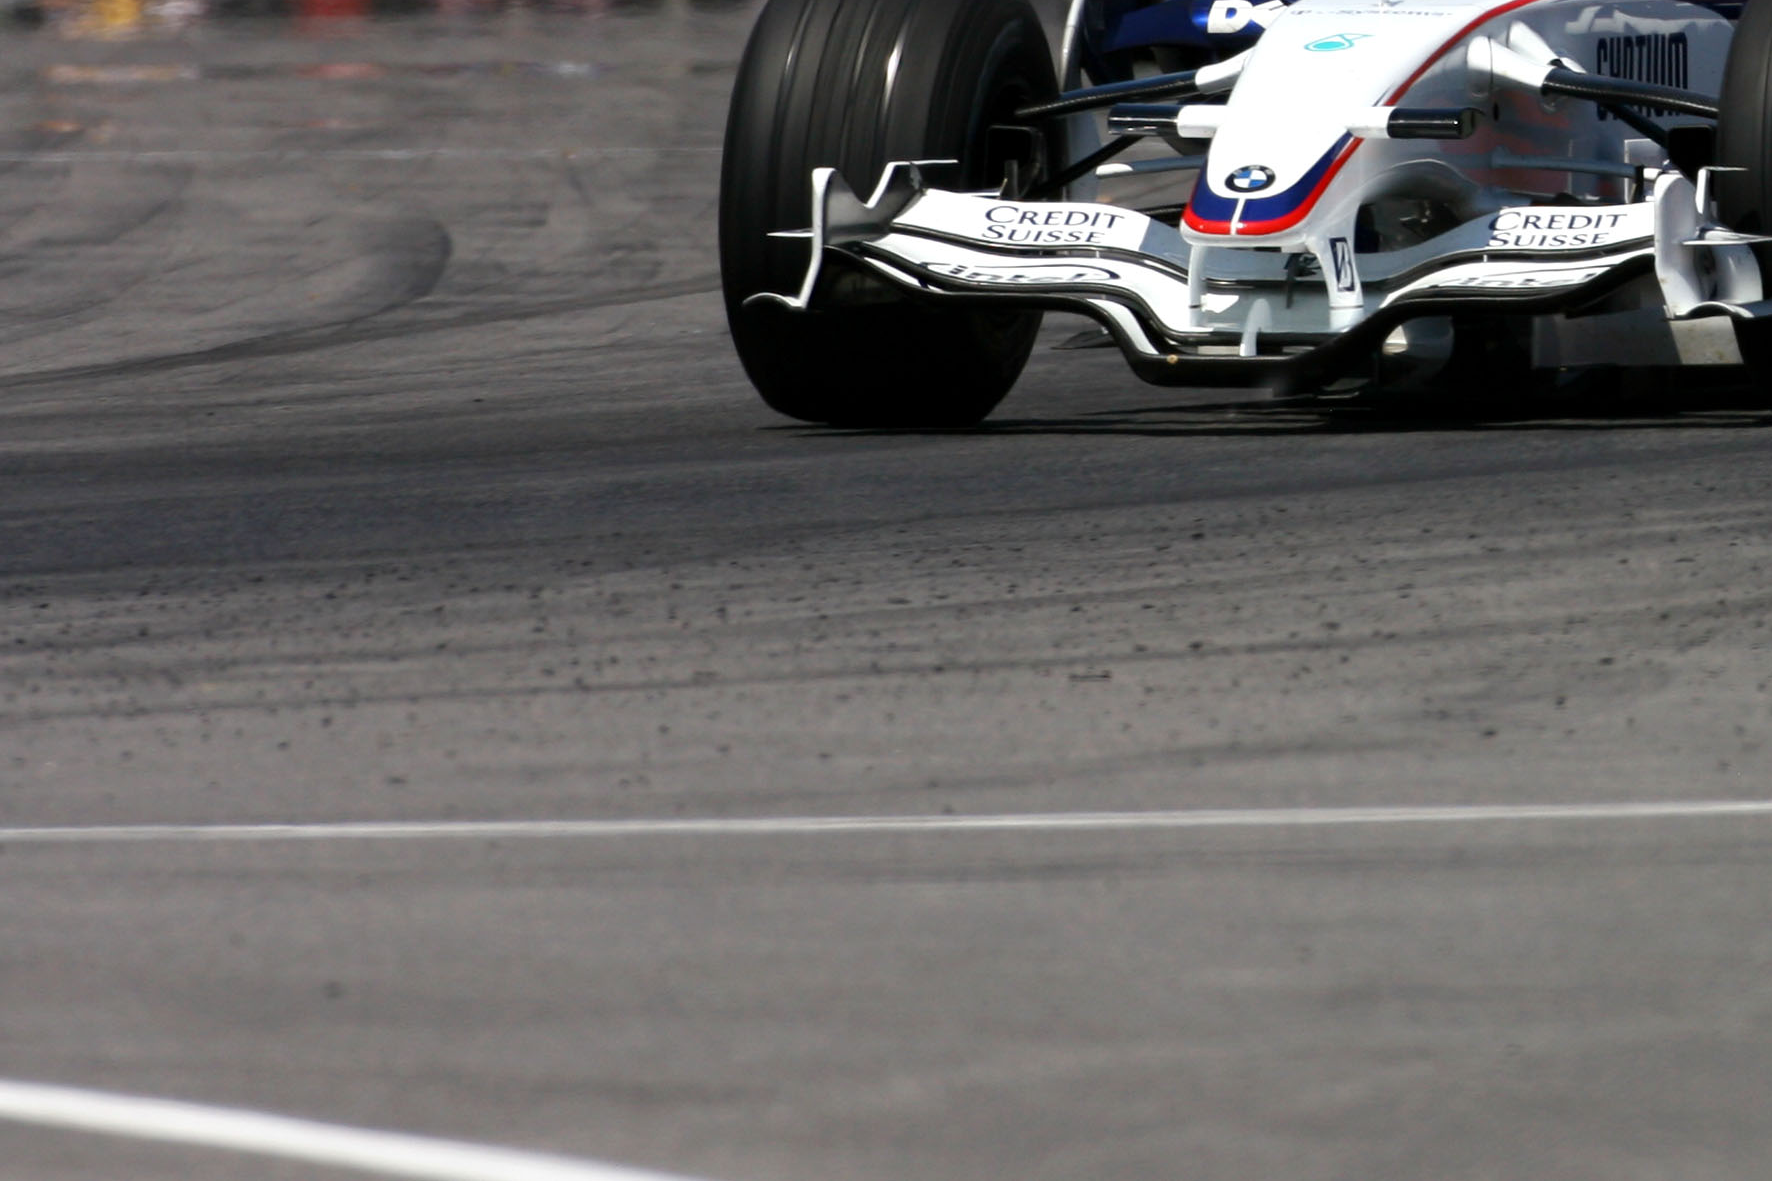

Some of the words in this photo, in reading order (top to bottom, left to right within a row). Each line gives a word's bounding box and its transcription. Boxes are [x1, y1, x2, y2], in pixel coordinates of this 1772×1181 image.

[984, 205, 1125, 229] CREDIT
[1487, 211, 1628, 231] CREDIT
[981, 225, 1106, 244] SUISSE
[1486, 232, 1610, 248] SUISSE
